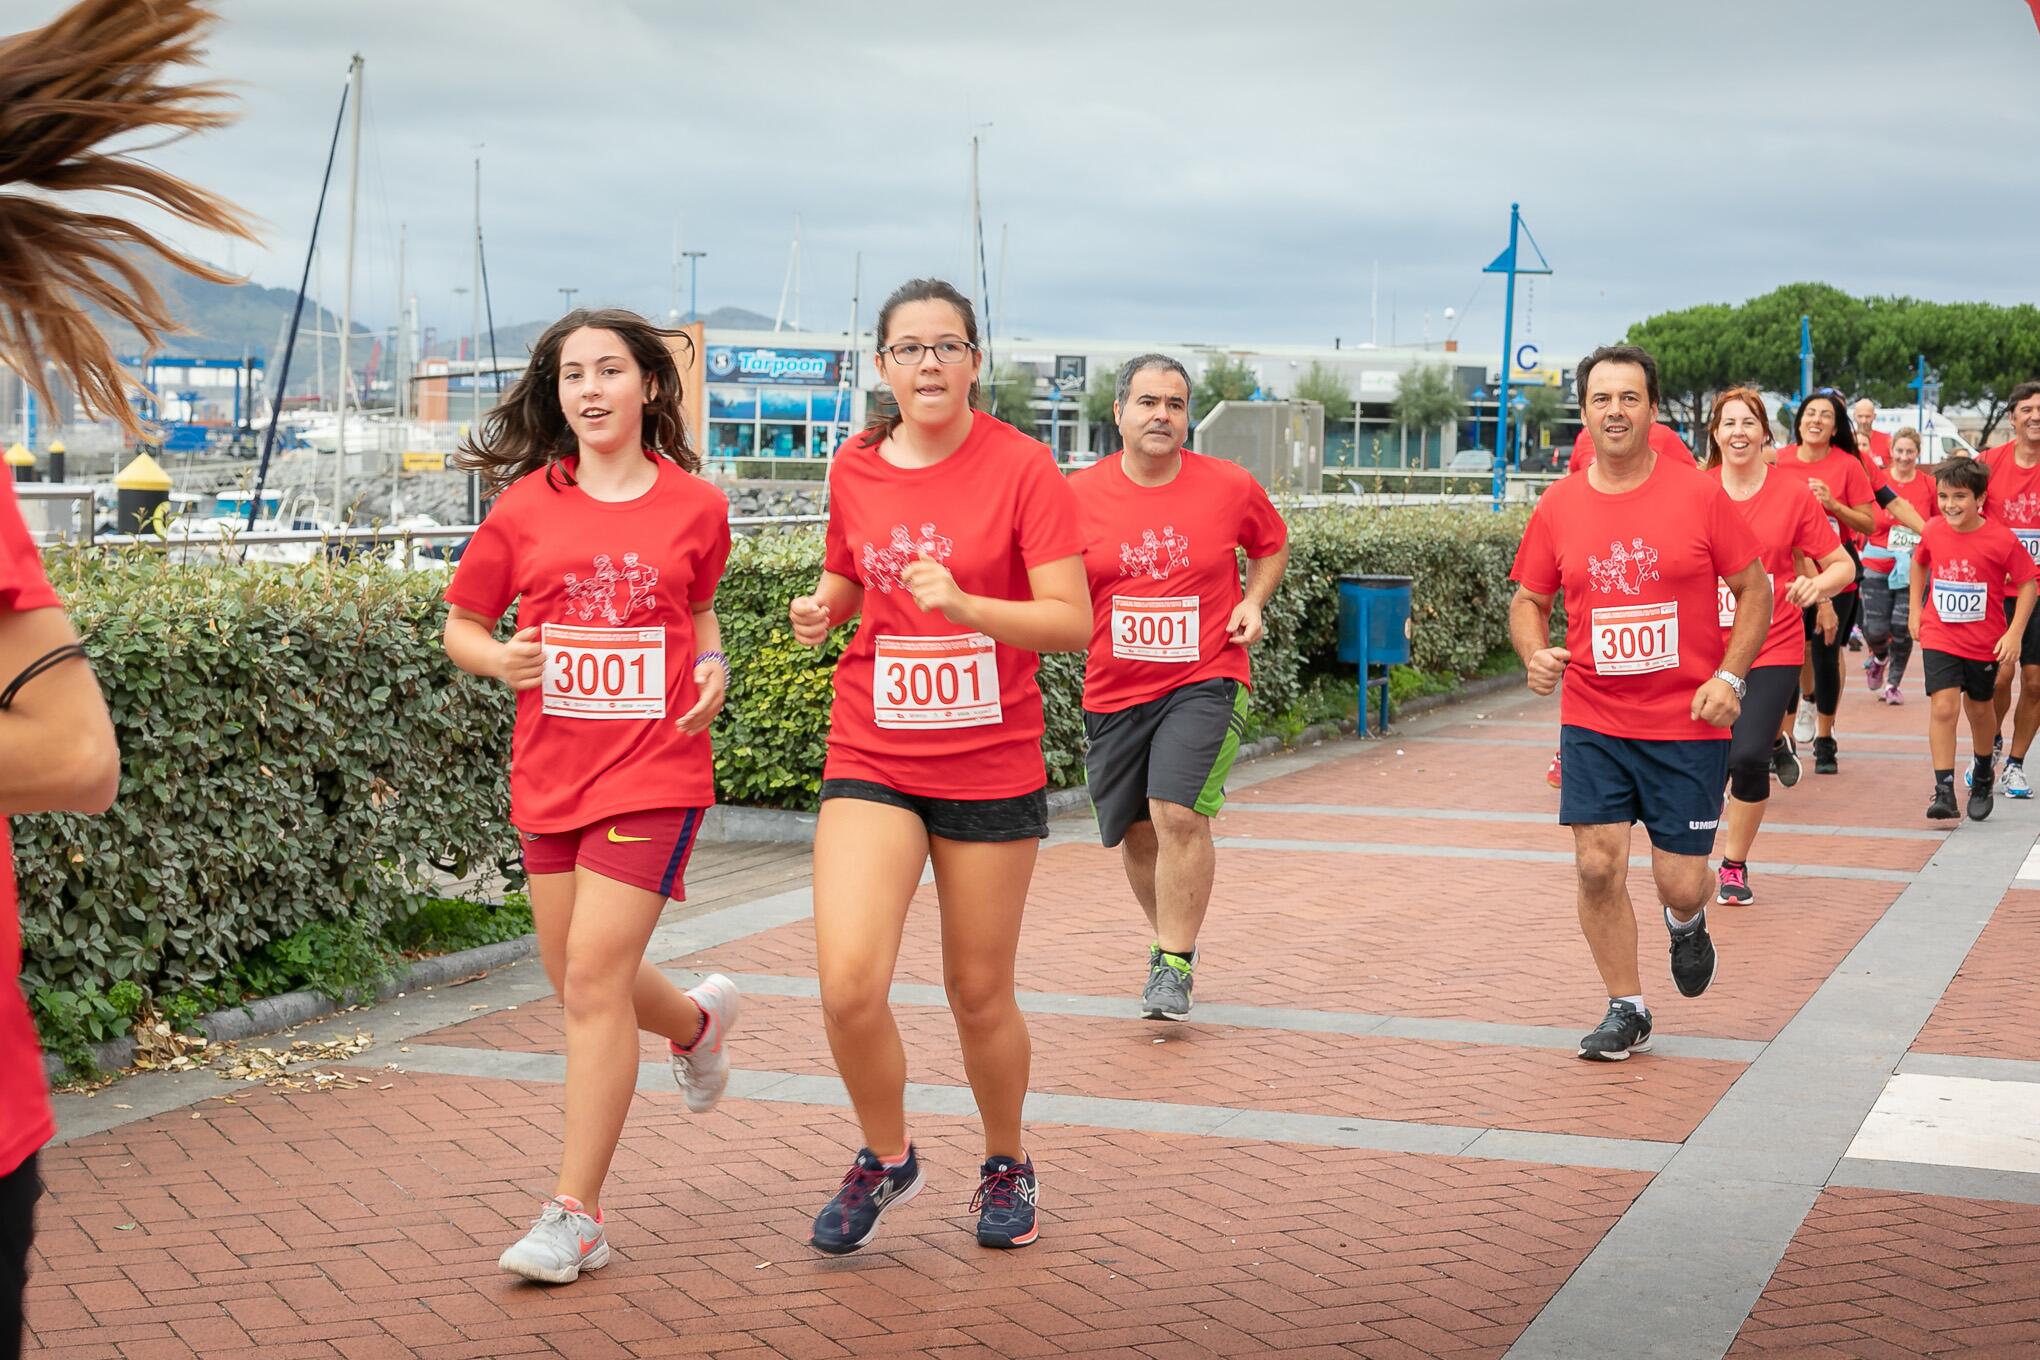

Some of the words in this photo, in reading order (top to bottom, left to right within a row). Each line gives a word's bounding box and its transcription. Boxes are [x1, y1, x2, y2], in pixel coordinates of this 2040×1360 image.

[740, 353, 825, 376] Tarpoon
[1516, 344, 1538, 370] C
[1938, 592, 1981, 612] 1002
[1121, 615, 1187, 646] 3001
[1601, 623, 1666, 660] 3001
[554, 651, 645, 696] 3001
[887, 661, 980, 706] 3001
